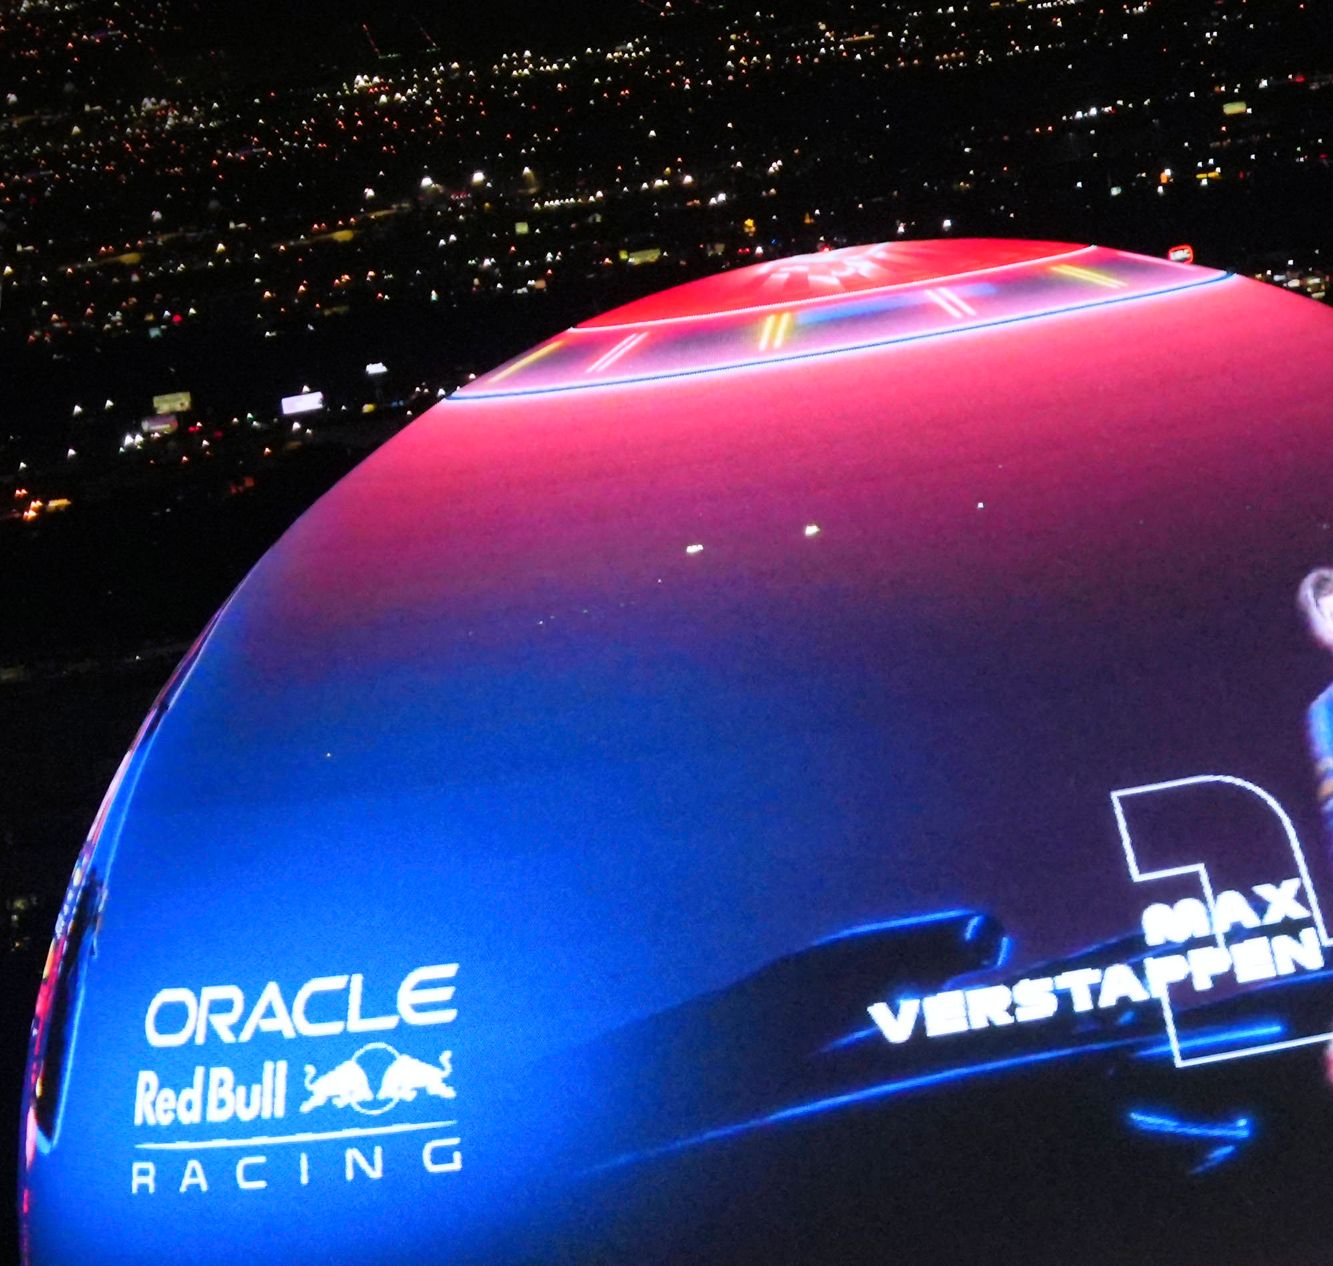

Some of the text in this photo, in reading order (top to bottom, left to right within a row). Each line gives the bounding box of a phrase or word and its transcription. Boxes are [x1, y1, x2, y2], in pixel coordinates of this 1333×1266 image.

[1142, 877, 1311, 946] MAX
[145, 962, 460, 1048] ORACLE
[867, 927, 1324, 1044] VERSTAPPEN
[131, 1137, 462, 1194] RACING
